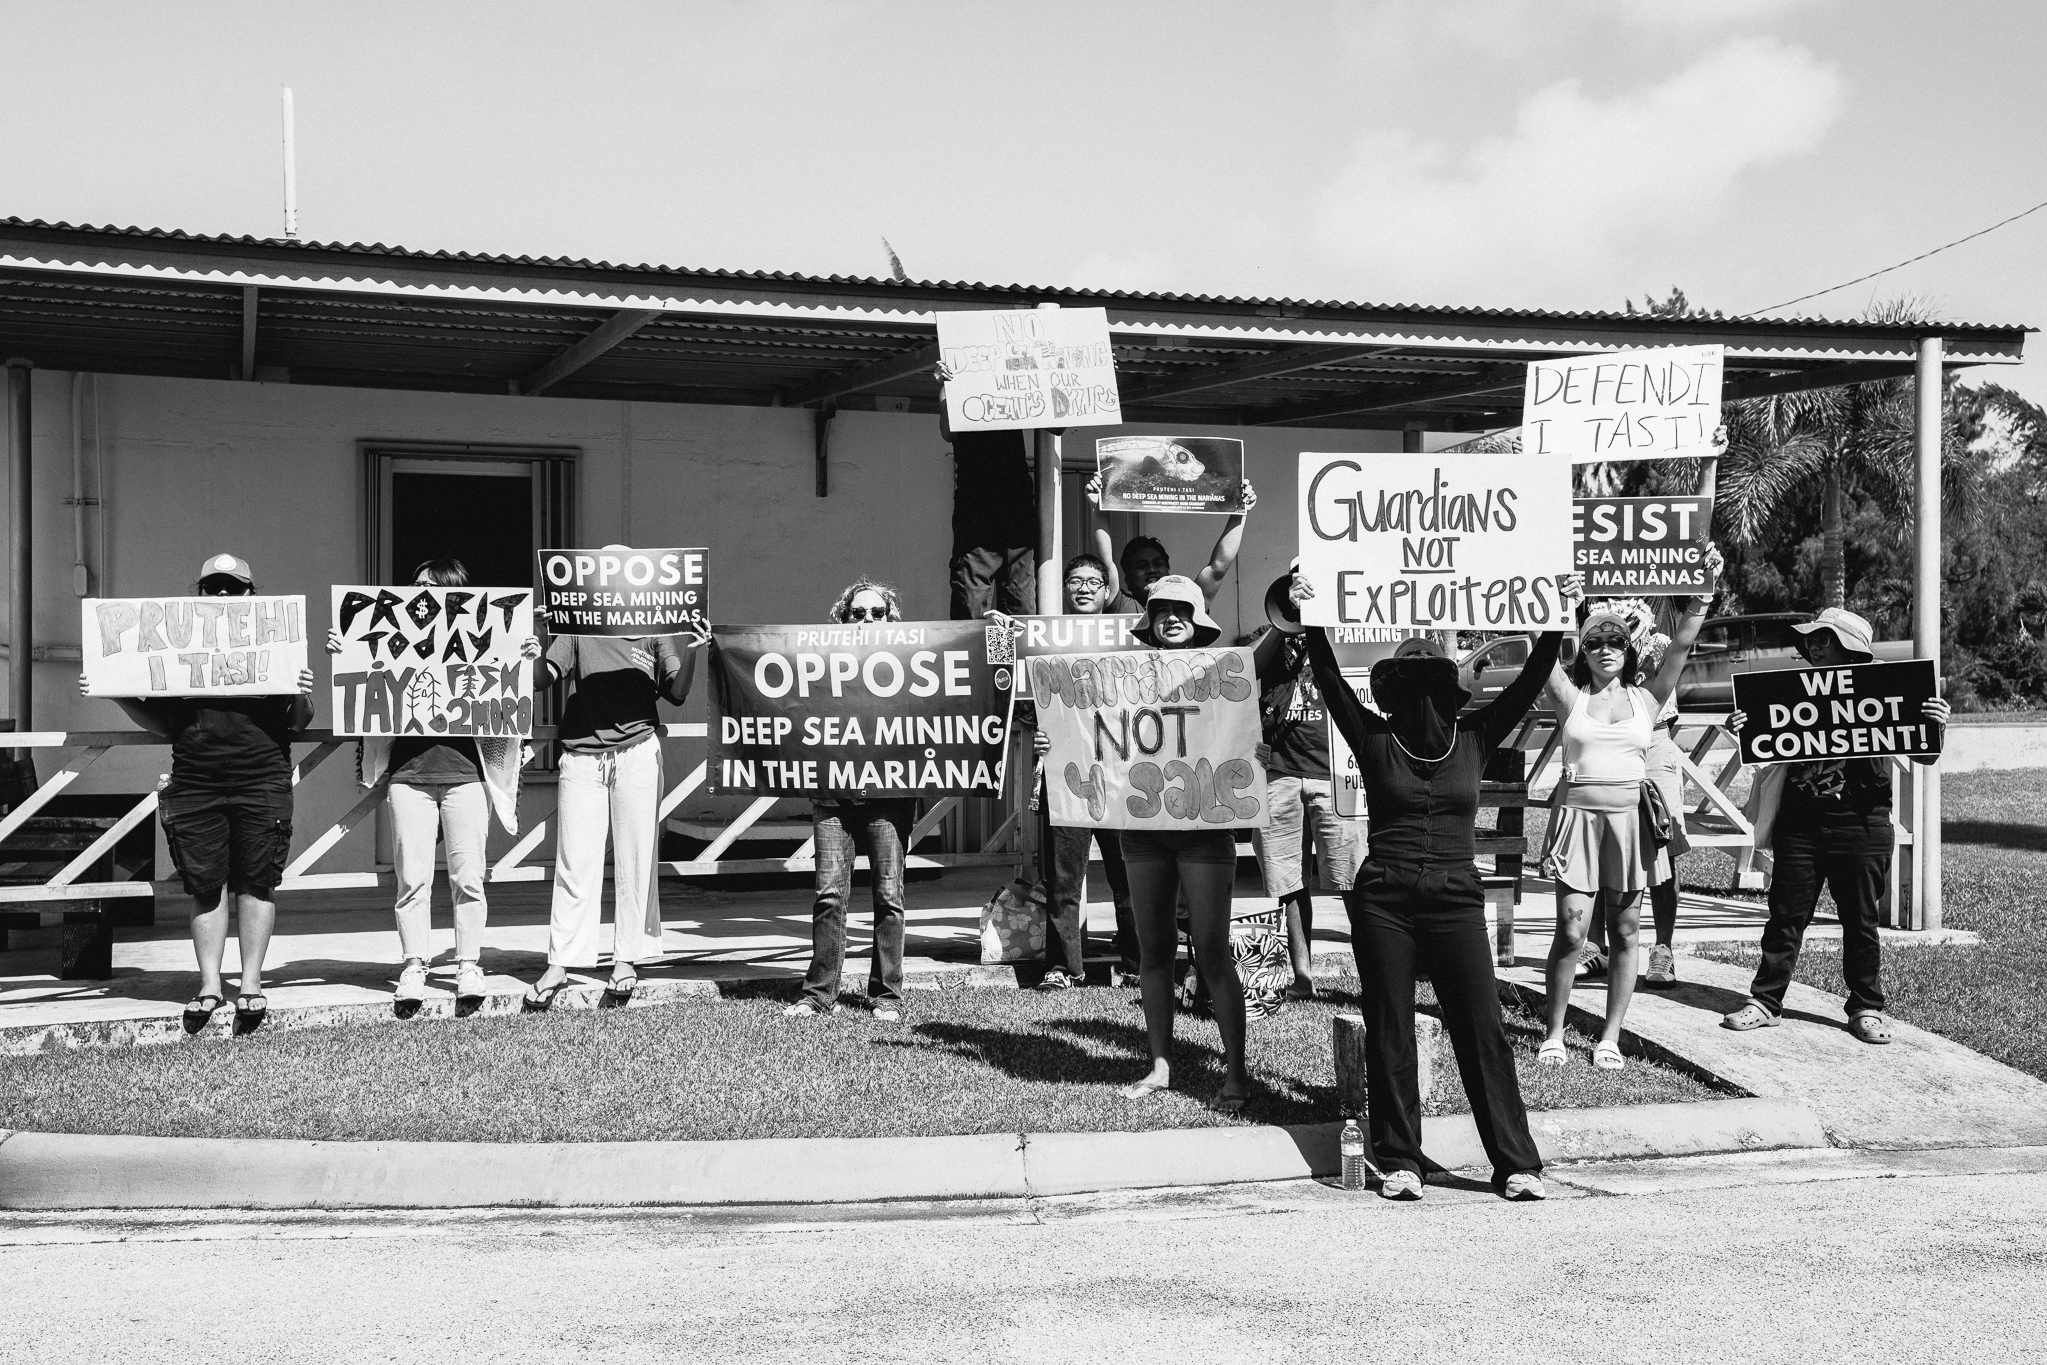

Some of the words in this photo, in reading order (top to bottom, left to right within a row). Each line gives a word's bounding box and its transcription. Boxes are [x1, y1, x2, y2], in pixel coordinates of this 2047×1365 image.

[993, 313, 1044, 342] NO
[943, 345, 1000, 374] DEEP
[995, 373, 1039, 391] WHEN
[1050, 372, 1081, 387] OUR
[1530, 419, 1552, 454] I
[1584, 411, 1703, 453] TASI!
[1122, 492, 1131, 500] NO
[1187, 494, 1198, 502] THE
[1573, 503, 1699, 542] ESIST
[1402, 537, 1460, 568] NOT
[1576, 548, 1615, 565] SEA
[1621, 547, 1700, 564] MINING
[546, 554, 703, 586] OPPOSE
[1593, 564, 1705, 586] MARIÅNAS
[339, 589, 530, 637] PROFIT
[551, 592, 587, 606] DEEP
[593, 592, 625, 606] SEA
[630, 591, 697, 606] MINING
[96, 600, 300, 657] PRUTEHI
[554, 611, 570, 624] IN
[573, 611, 602, 625] THE
[606, 606, 701, 625] MARIÅNAS
[797, 630, 869, 647] PRUTEHI
[875, 630, 880, 645] I
[886, 628, 925, 645] TASI
[1334, 627, 1402, 644] PARKING
[149, 656, 167, 691] I
[754, 650, 972, 698] OPPOSE
[1800, 669, 1854, 697] WE
[446, 696, 532, 735] 2MORO
[1769, 701, 1819, 729] DO
[1830, 696, 1904, 724] NOT
[721, 716, 792, 745] DEEP
[802, 716, 866, 746] SEA
[874, 715, 1004, 745] MINING
[1093, 706, 1201, 761] NOT
[1751, 724, 1929, 759] CONSENT!
[722, 760, 756, 788] IN
[762, 760, 818, 789] THE
[1064, 762, 1106, 821] 4
